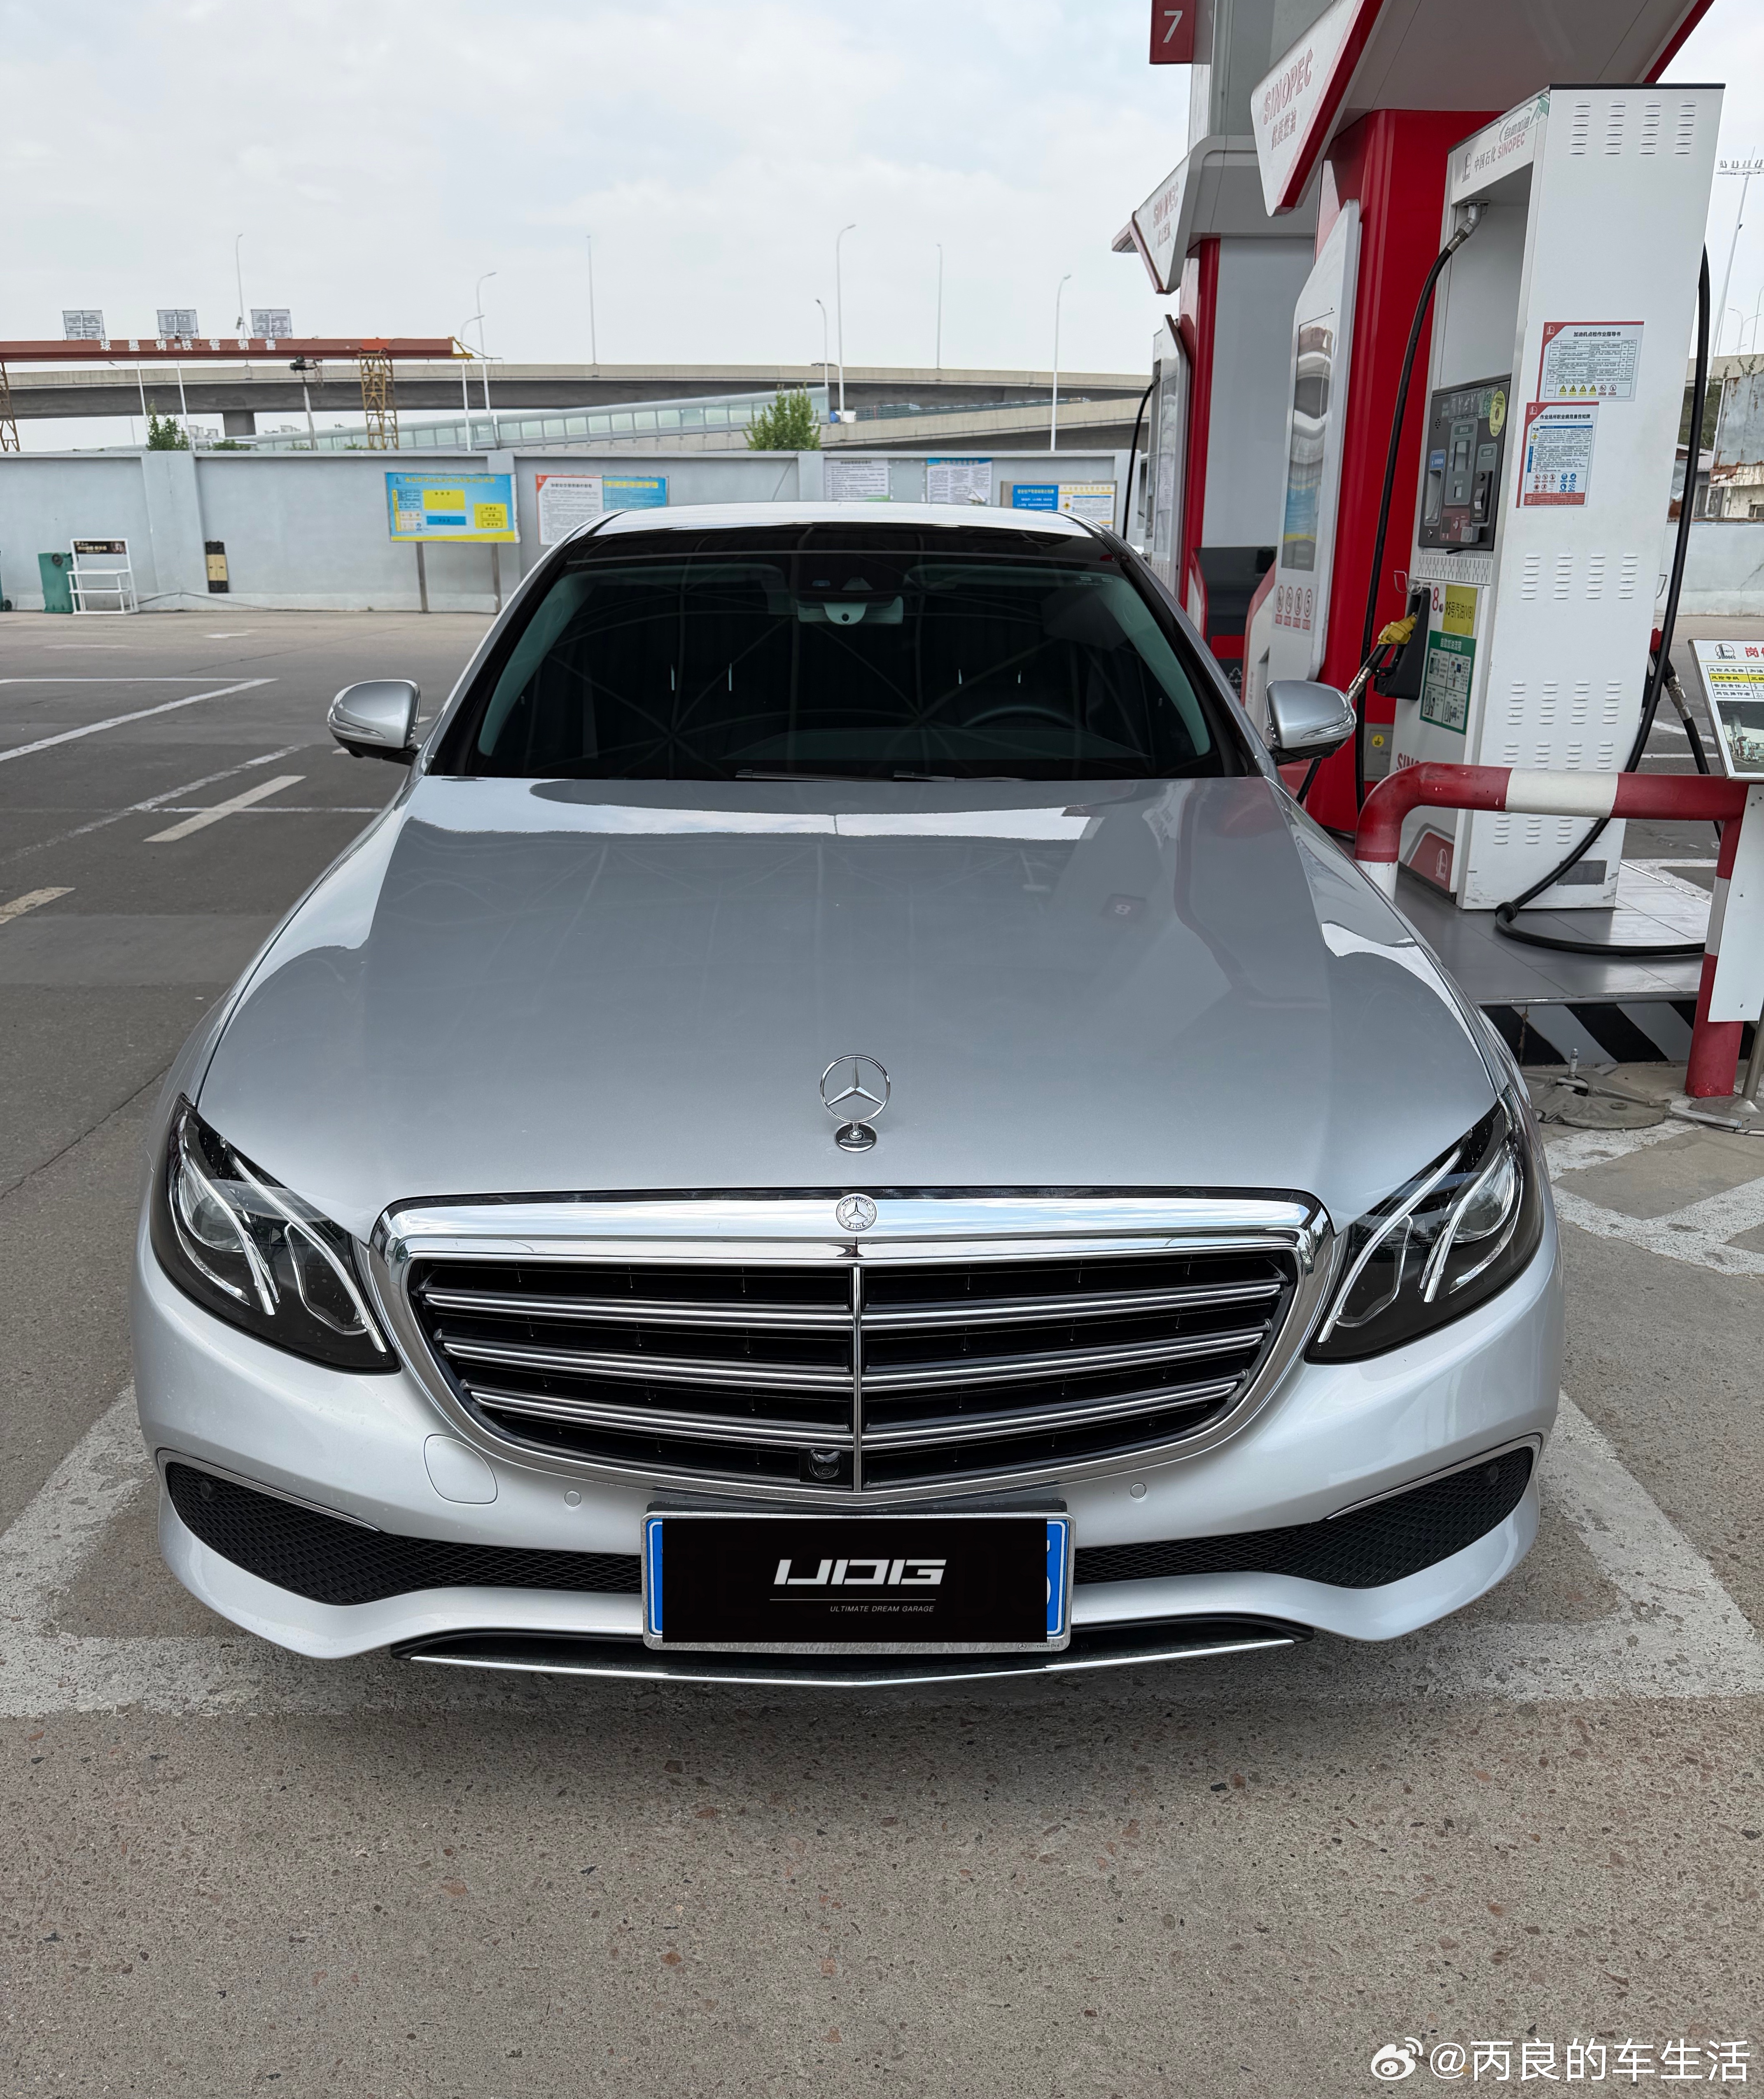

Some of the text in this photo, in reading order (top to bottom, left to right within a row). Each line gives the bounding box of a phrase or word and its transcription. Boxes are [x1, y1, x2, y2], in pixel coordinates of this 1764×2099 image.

[1163, 10, 1183, 43] 7
[1263, 49, 1313, 125] SINOPEC
[1504, 116, 1531, 141] 自助加油
[1474, 132, 1525, 173] 中国石化 SINOPEC
[1432, 587, 1439, 611] 8
